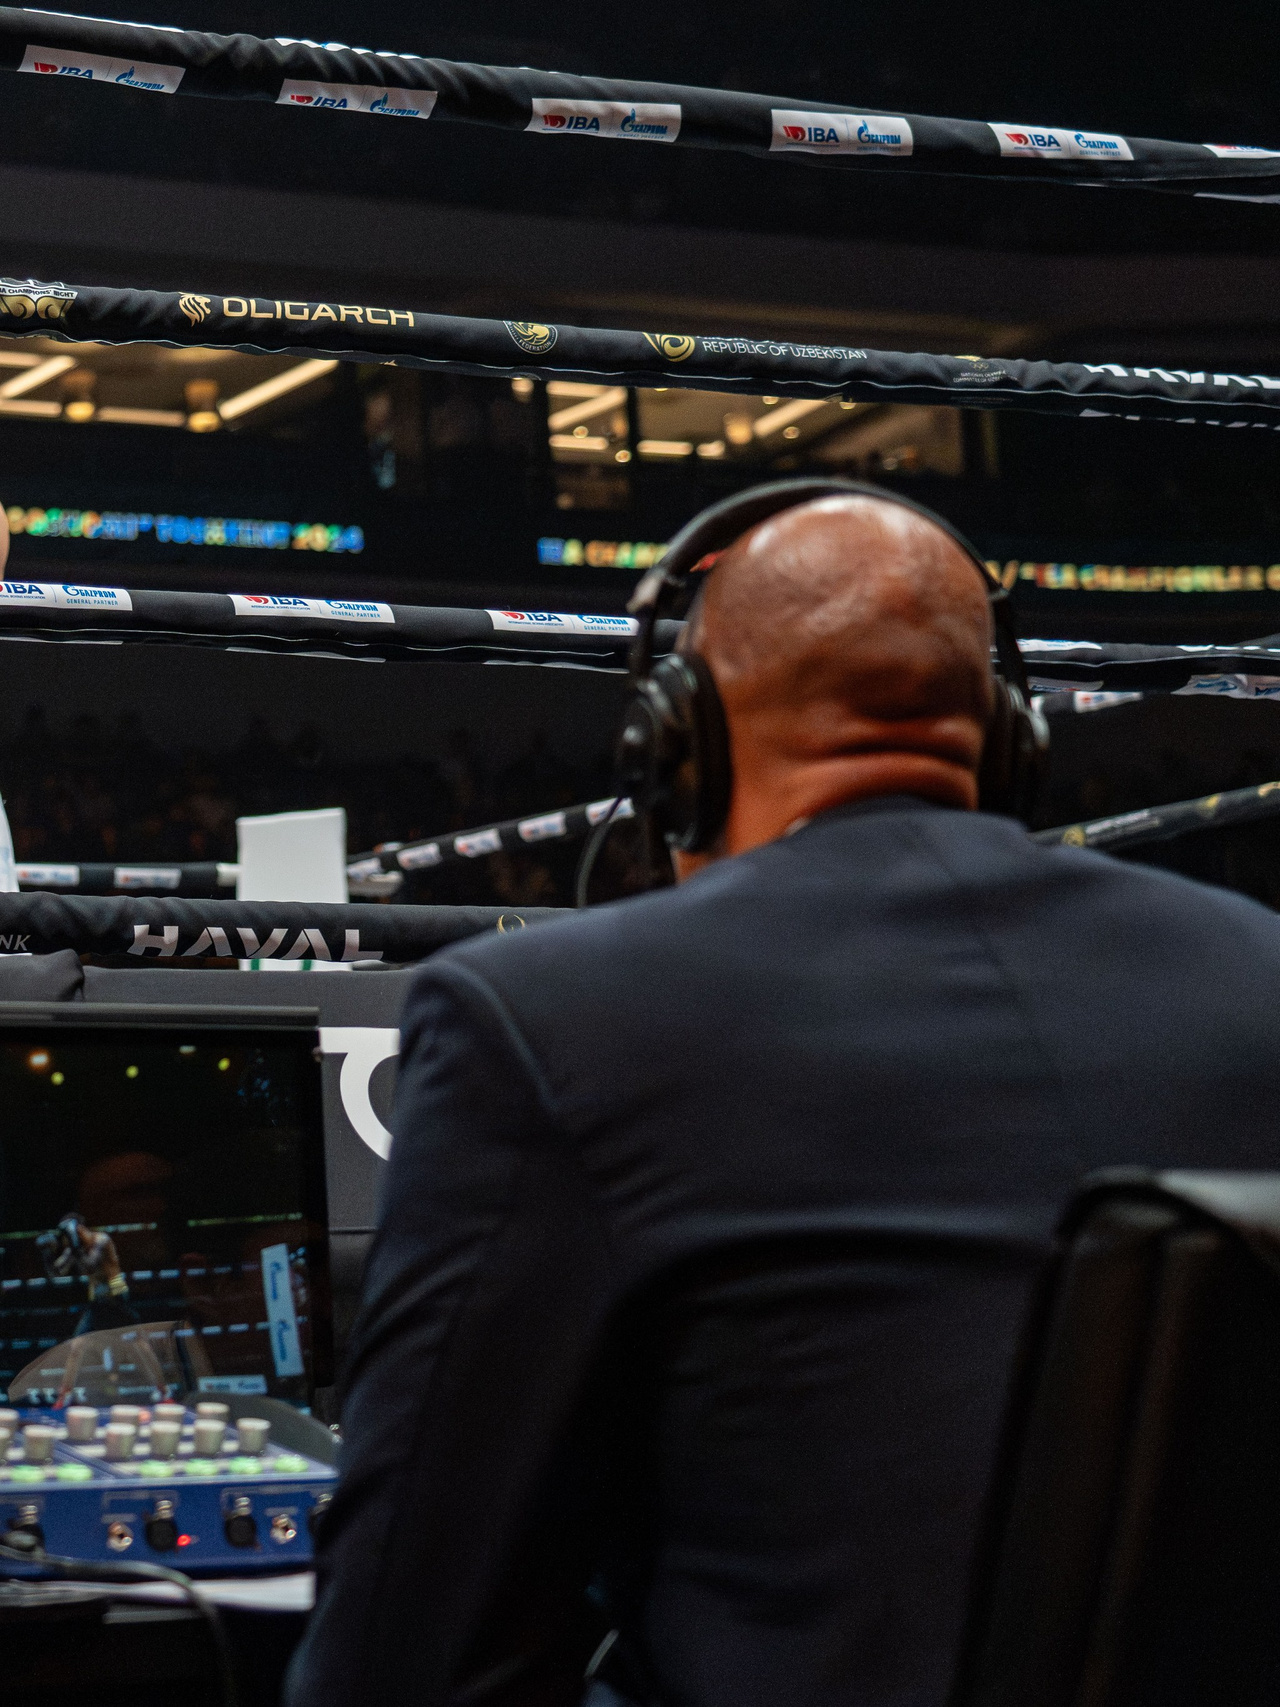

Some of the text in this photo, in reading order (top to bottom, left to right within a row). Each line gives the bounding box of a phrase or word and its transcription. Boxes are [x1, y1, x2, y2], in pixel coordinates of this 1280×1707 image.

[565, 116, 600, 131] IBA
[807, 126, 840, 143] IBA
[1027, 133, 1061, 148] IBA
[222, 298, 415, 327] OLIGARCH
[702, 341, 767, 355] REPUBLIC
[769, 345, 788, 356] OF
[789, 346, 868, 360] UZBEKISTAN
[6, 583, 45, 595] IBA
[66, 598, 92, 606] GENERAL
[331, 610, 381, 619] GENERAL PARTNER
[127, 924, 384, 961] HAVAL
